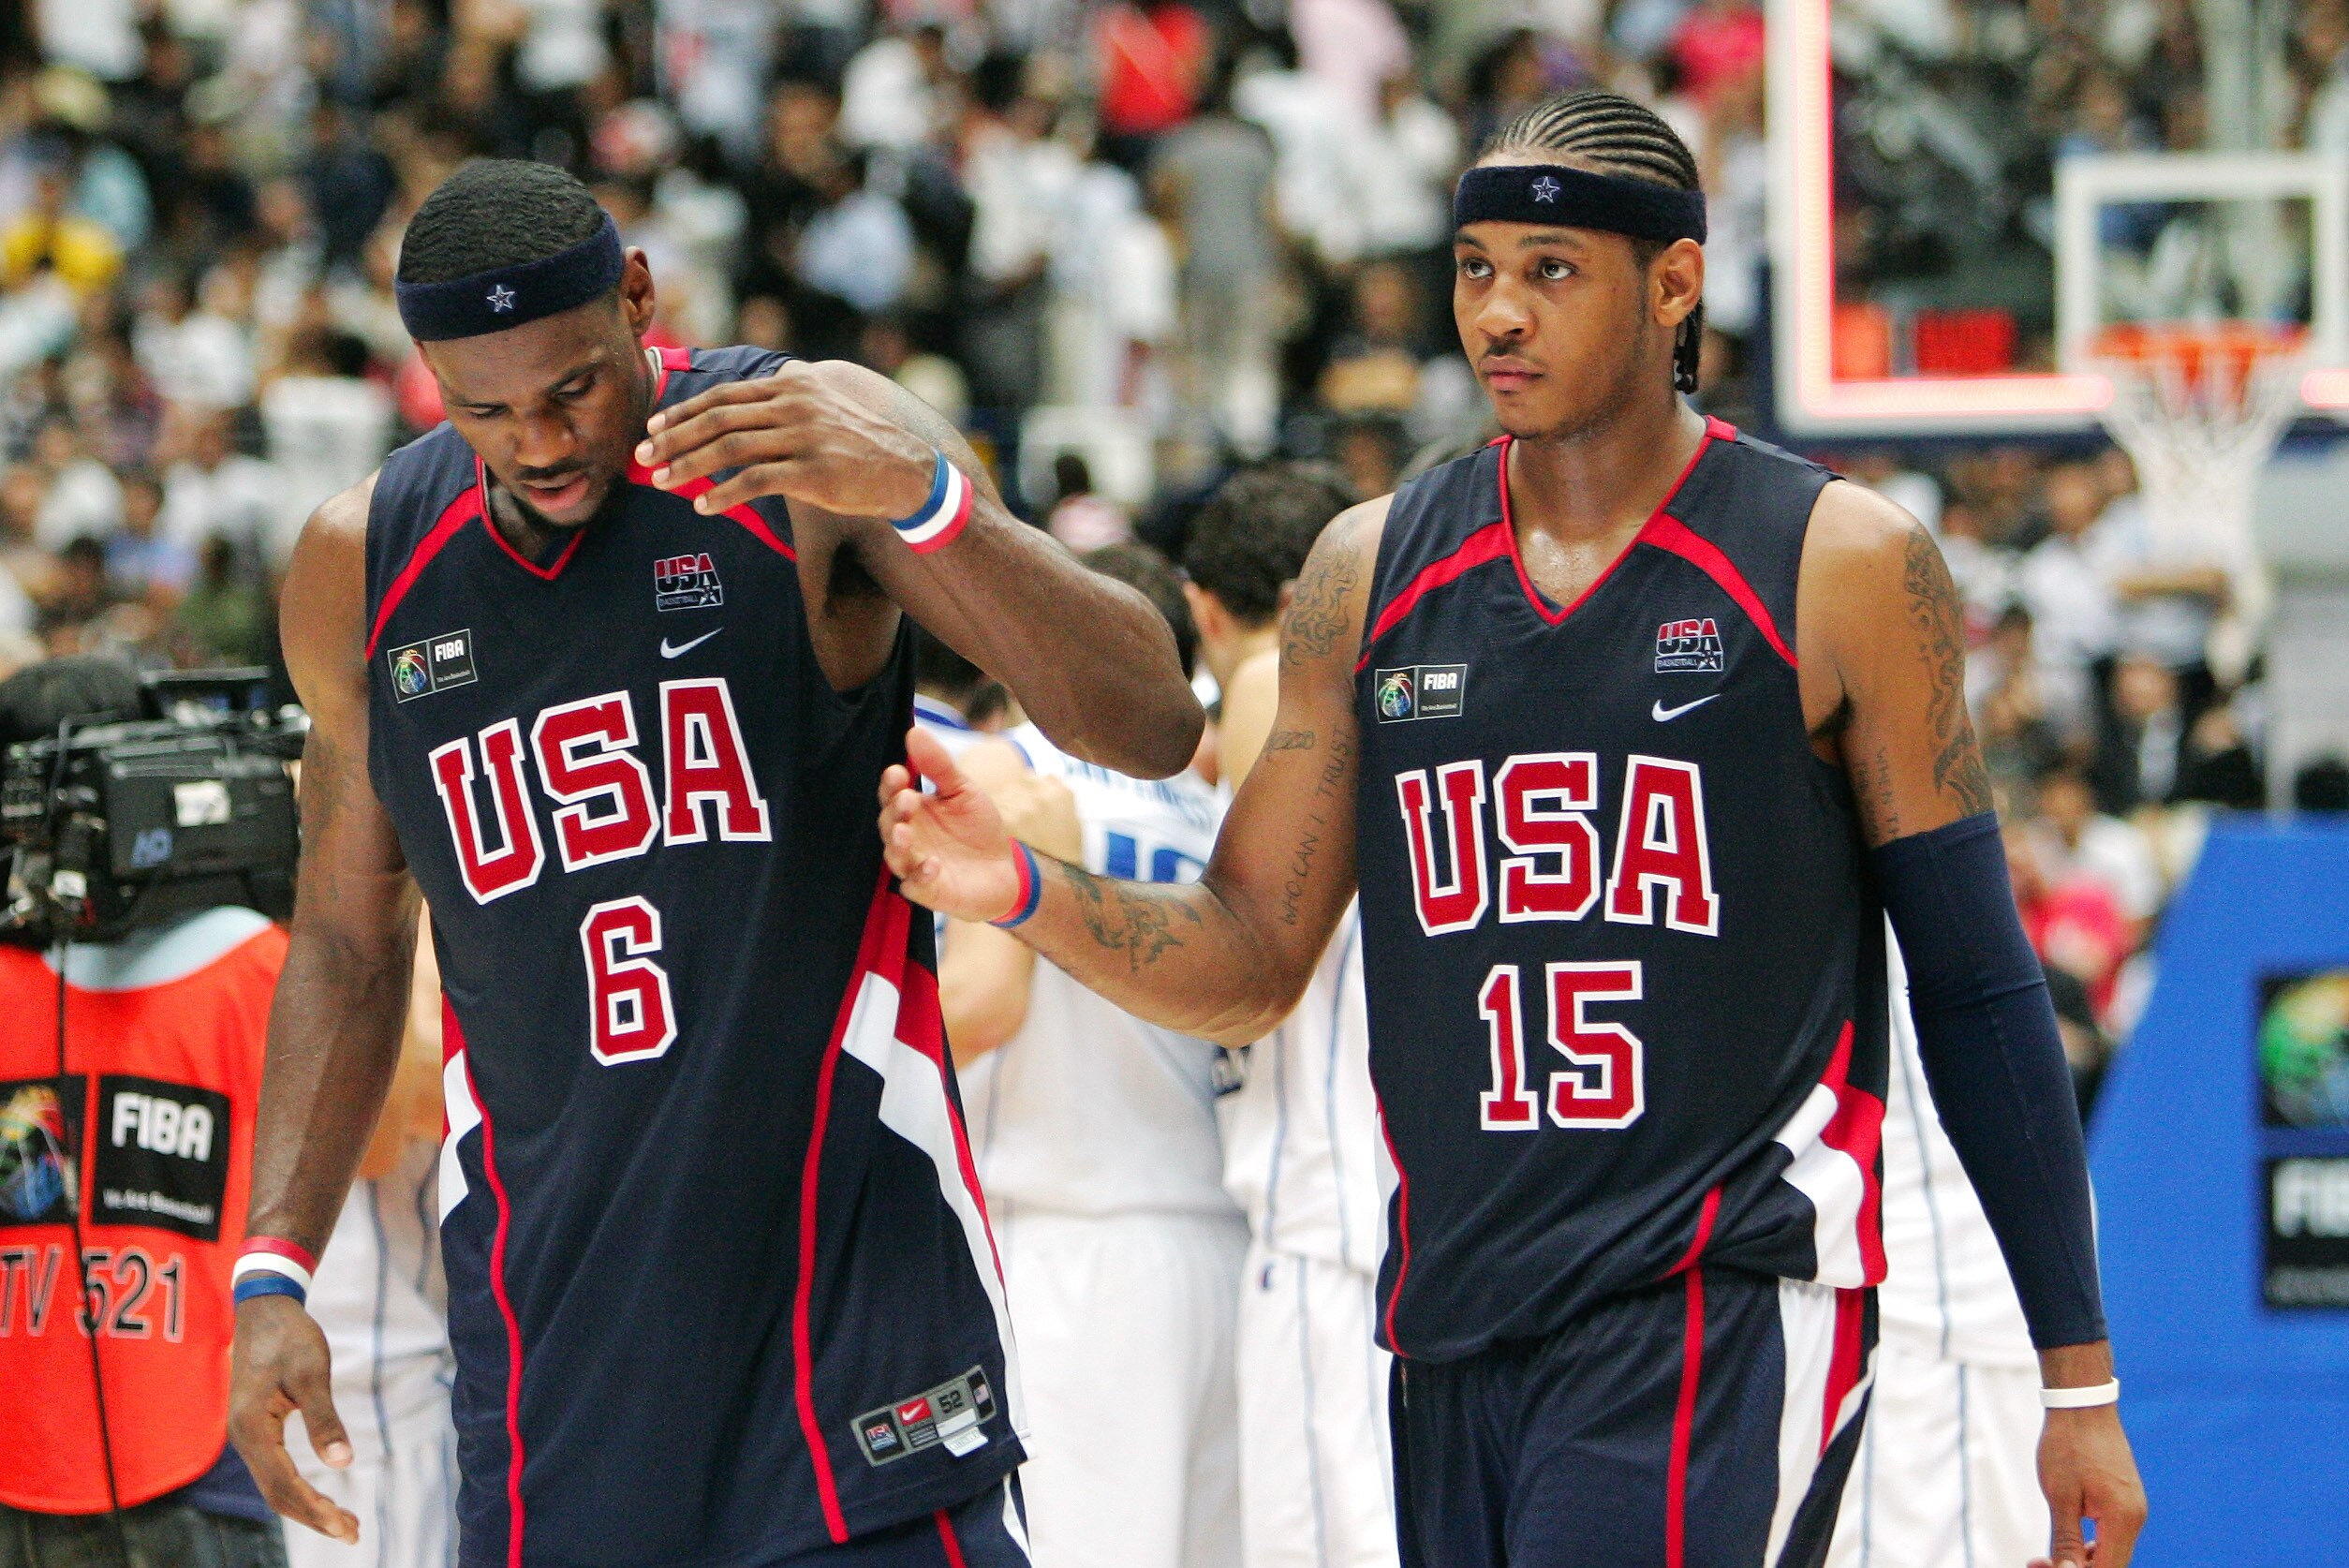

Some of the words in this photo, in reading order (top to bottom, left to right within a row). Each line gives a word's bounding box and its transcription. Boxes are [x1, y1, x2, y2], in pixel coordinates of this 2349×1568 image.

[655, 553, 721, 595] USA
[435, 639, 465, 662] FIBA
[1656, 618, 1722, 656] USA
[1424, 673, 1457, 690] FIBA
[428, 677, 773, 906] USA
[1292, 832, 1319, 877] CAN
[1314, 725, 1351, 802] TRUST
[1395, 752, 1720, 938] USA
[580, 895, 678, 1067] 6
[1478, 960, 1646, 1131] 15
[111, 1091, 214, 1161] FIBA
[0, 1243, 62, 1338] TV
[75, 1245, 187, 1343] 521
[938, 1390, 965, 1413] 52
